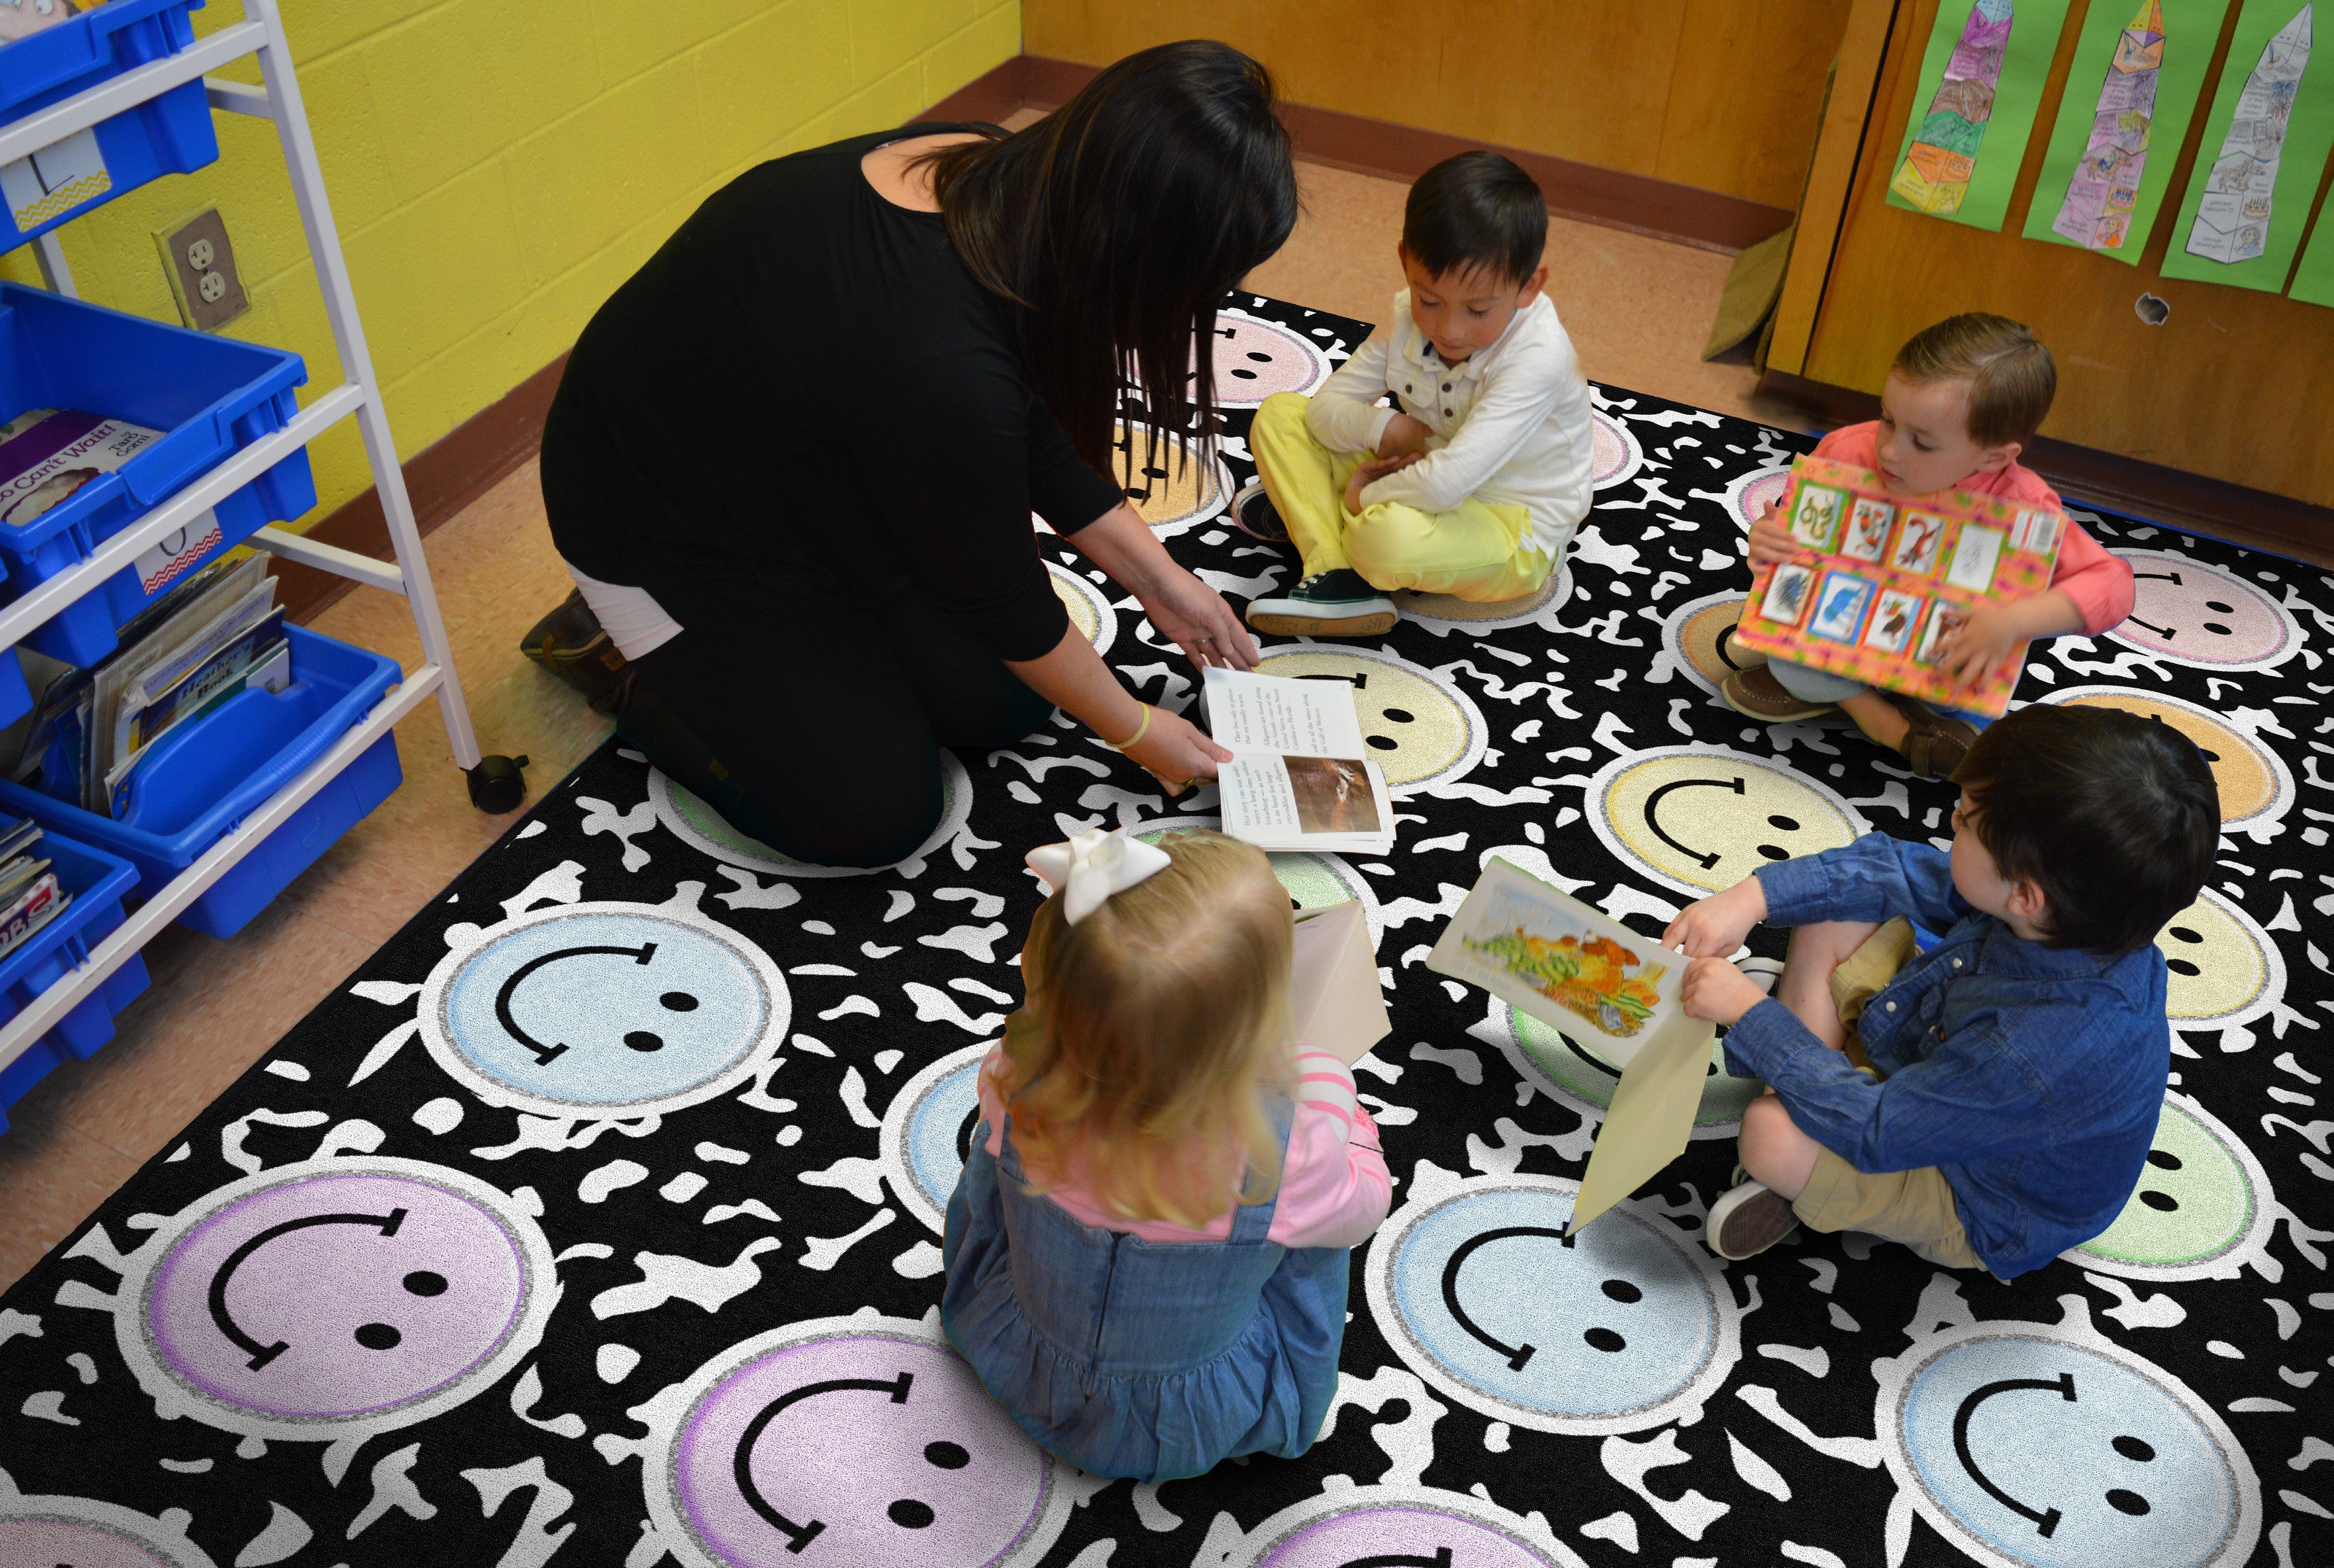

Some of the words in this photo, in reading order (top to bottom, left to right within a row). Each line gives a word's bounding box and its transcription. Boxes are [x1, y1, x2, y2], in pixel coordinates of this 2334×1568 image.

[109, 432, 139, 451] Taro
[116, 435, 151, 457] Gomi
[13, 457, 66, 489] Can't
[63, 424, 117, 458] Wait!
[1256, 701, 1264, 715] found
[1282, 733, 1290, 749] United
[1232, 766, 1240, 777] under
[1241, 760, 1249, 775] without
[1253, 770, 1262, 781] much
[1263, 798, 1271, 825] breathing
[1282, 796, 1292, 824] crocodiles
